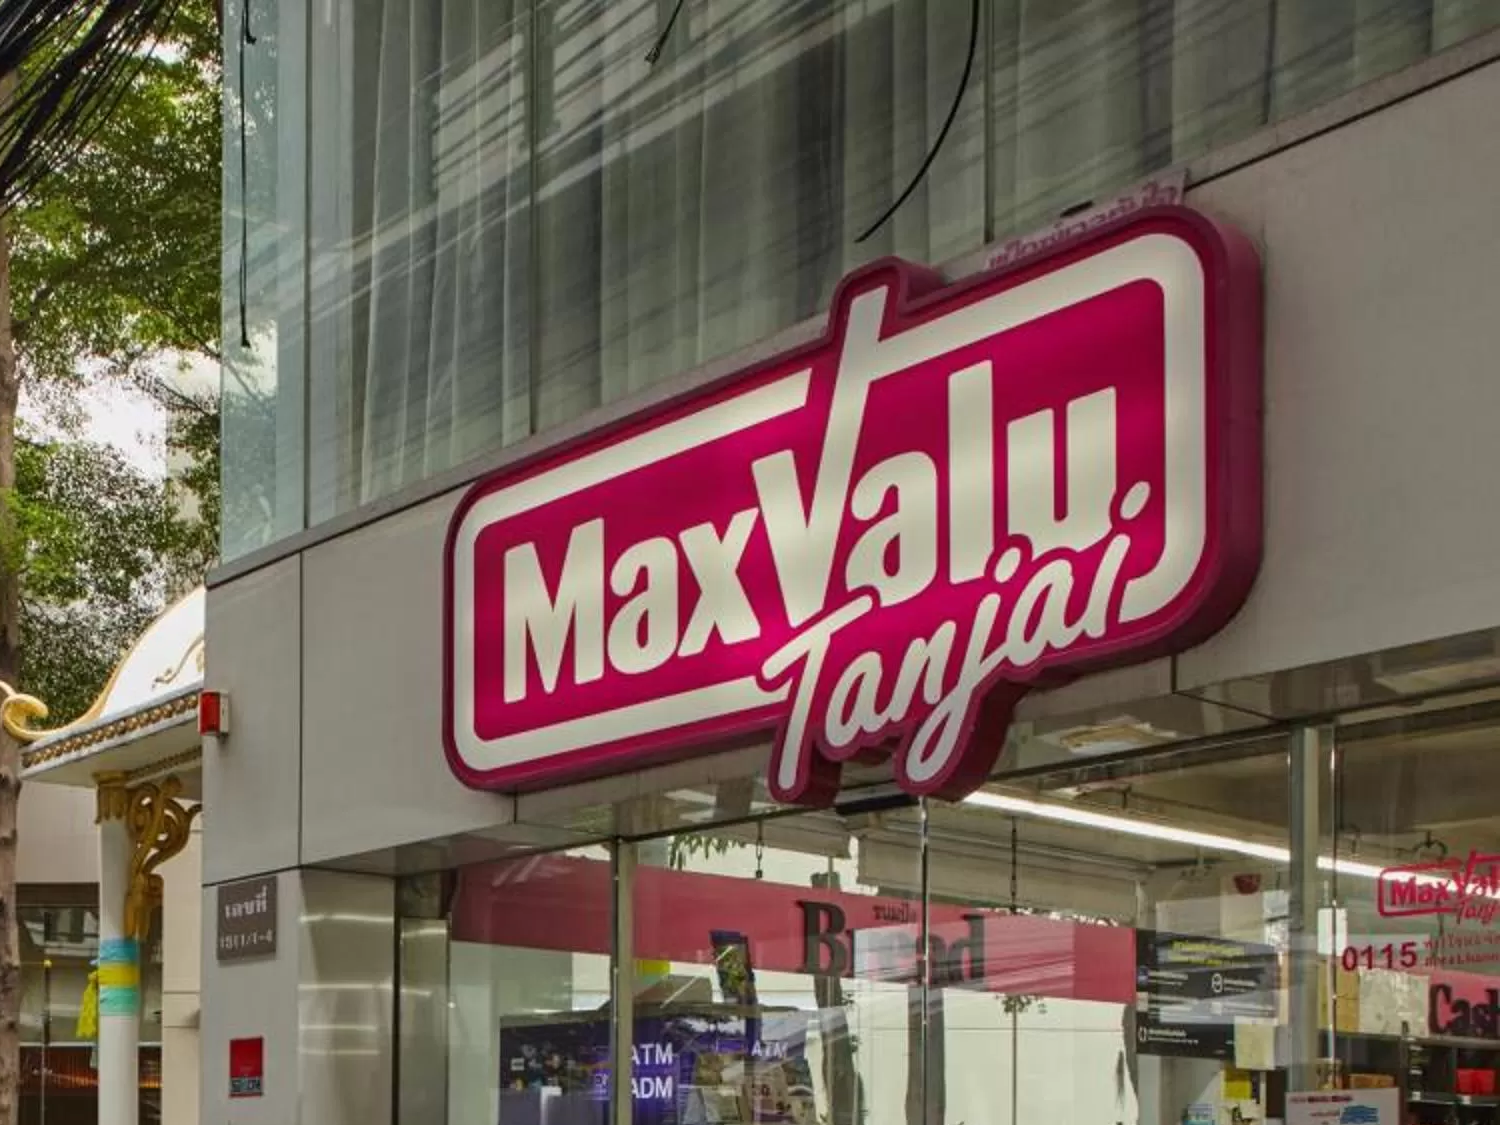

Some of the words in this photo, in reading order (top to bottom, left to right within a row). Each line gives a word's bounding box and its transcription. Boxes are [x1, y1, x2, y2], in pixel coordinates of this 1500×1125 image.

[503, 283, 1119, 704] MaxValu
[761, 480, 1152, 791] Tanjai
[1341, 941, 1418, 972] 0115
